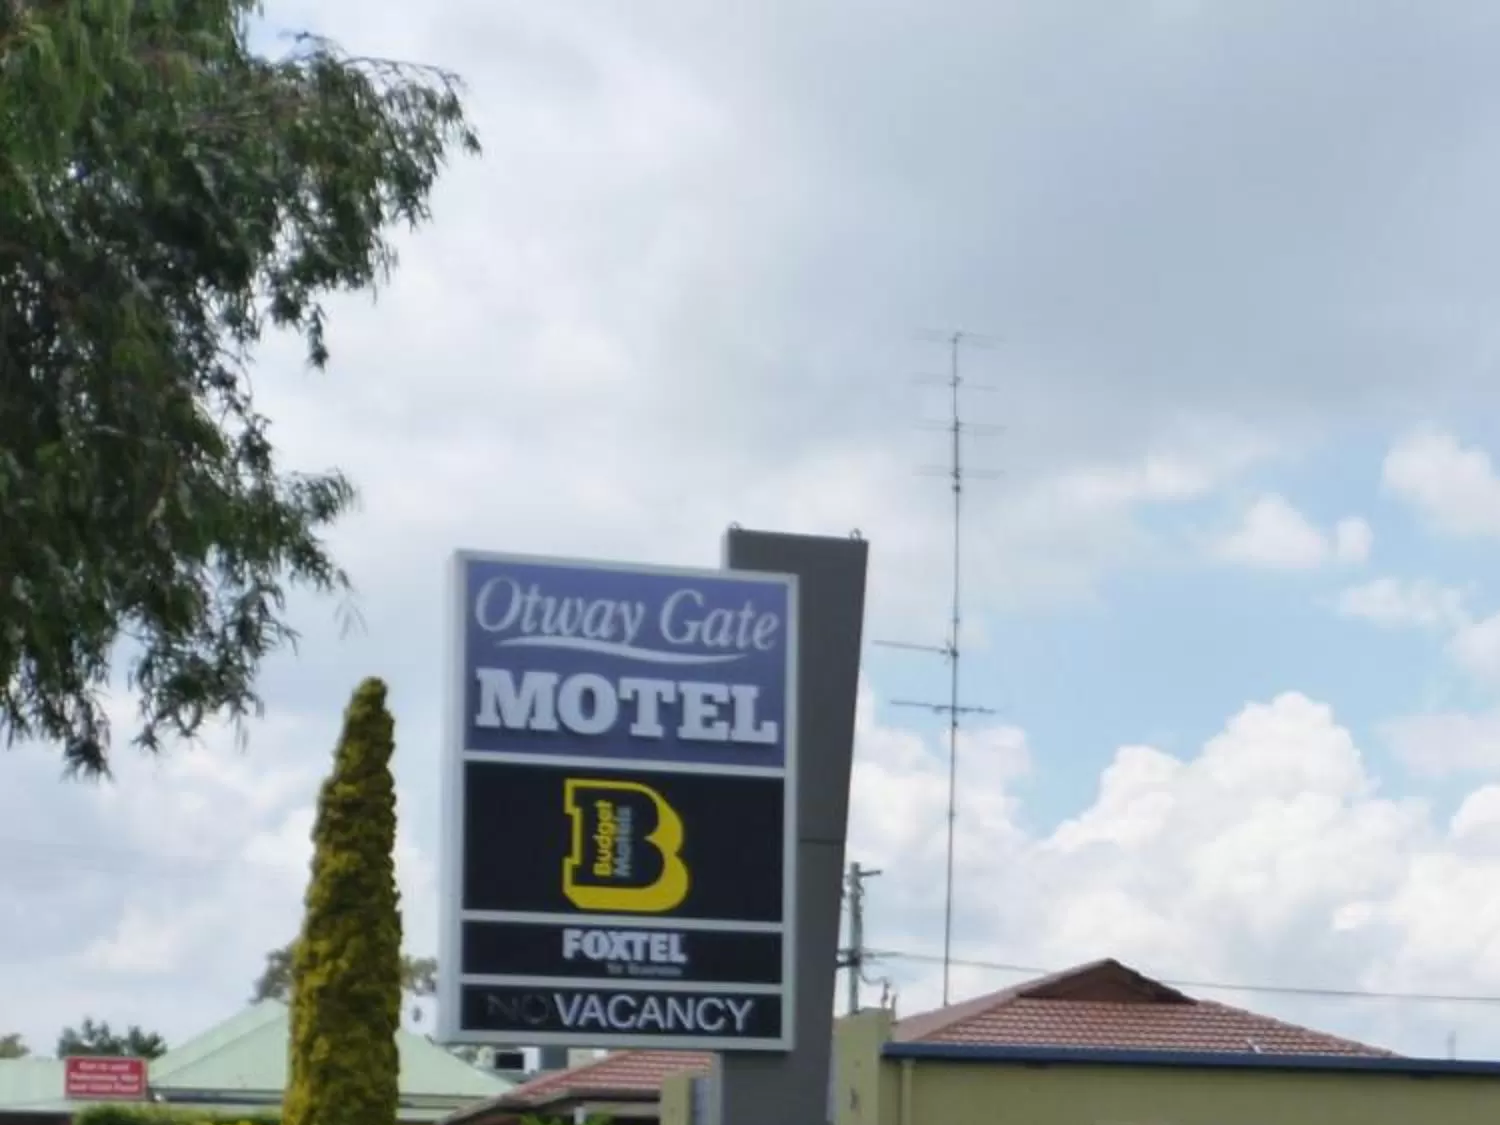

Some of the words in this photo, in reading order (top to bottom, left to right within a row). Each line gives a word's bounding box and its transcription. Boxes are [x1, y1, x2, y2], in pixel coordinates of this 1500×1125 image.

[475, 576, 645, 644] Otway
[659, 589, 779, 651] Gate
[474, 668, 779, 746] MOTEL
[593, 800, 613, 877] Budget
[562, 928, 687, 963] FOXTEL
[485, 994, 549, 1024] NO
[553, 992, 754, 1031] VACANCY
